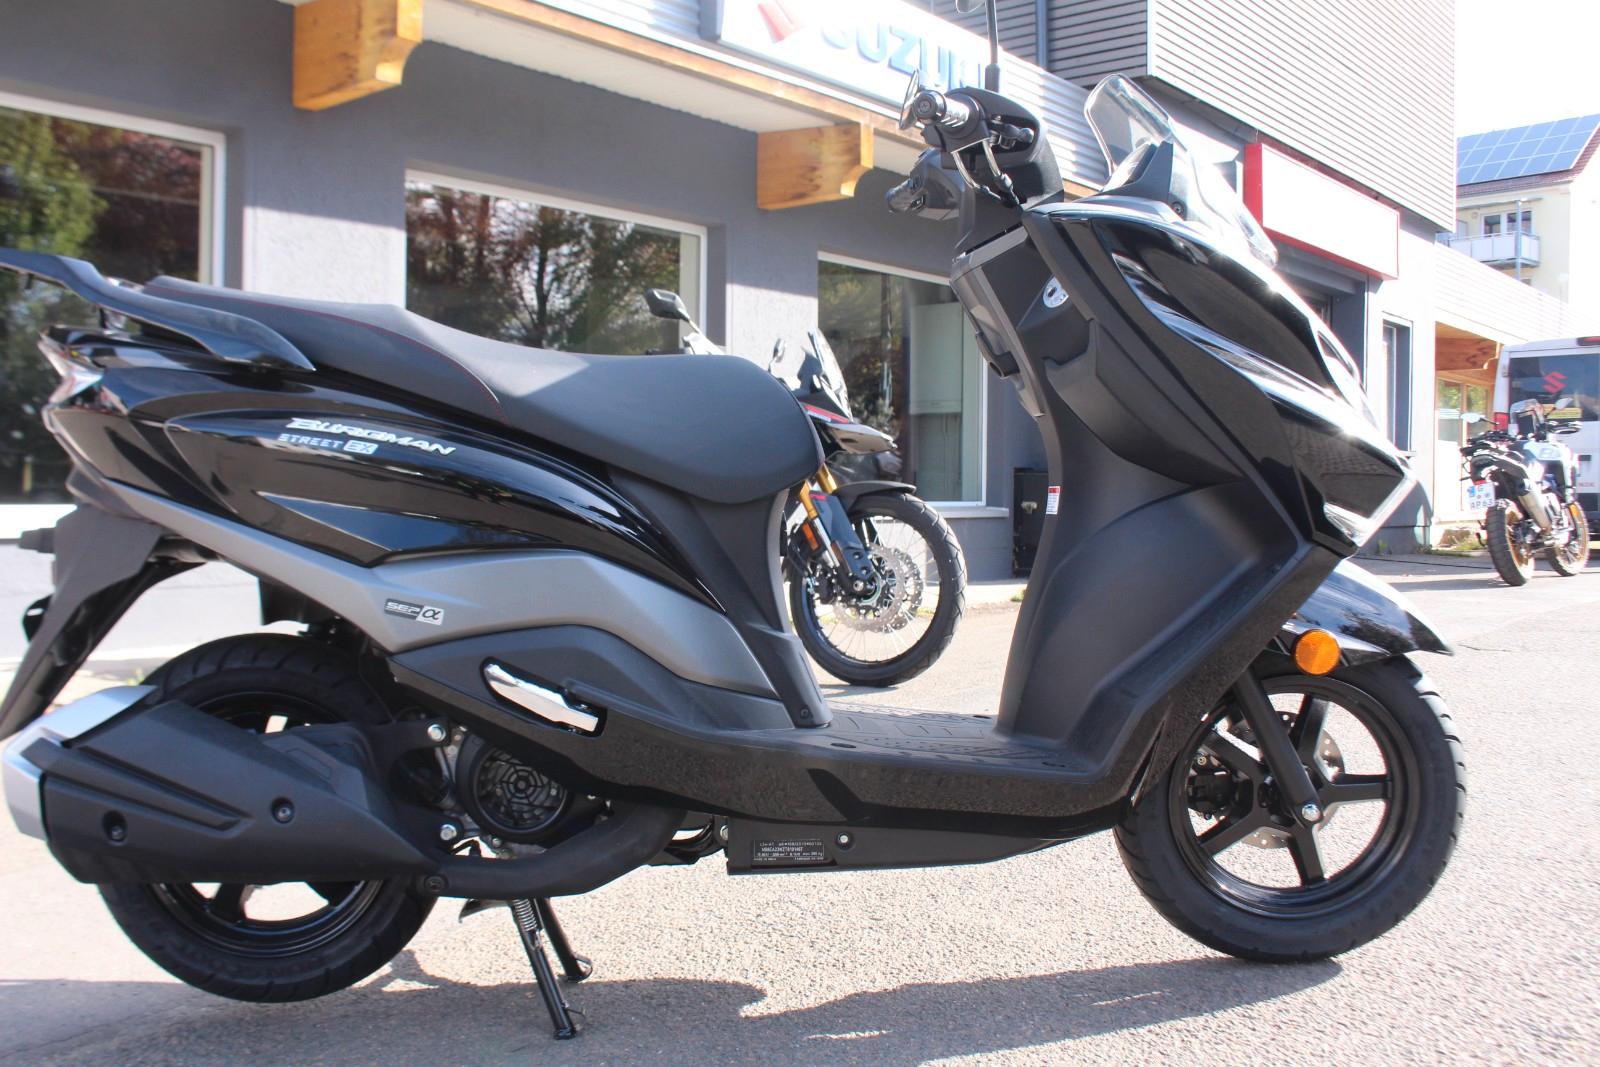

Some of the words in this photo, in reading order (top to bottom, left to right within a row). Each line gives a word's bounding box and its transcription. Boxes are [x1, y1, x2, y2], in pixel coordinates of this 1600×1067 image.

[278, 433, 343, 448] STREET
[286, 417, 456, 456] BURGMAN
[386, 601, 420, 617] SEP
